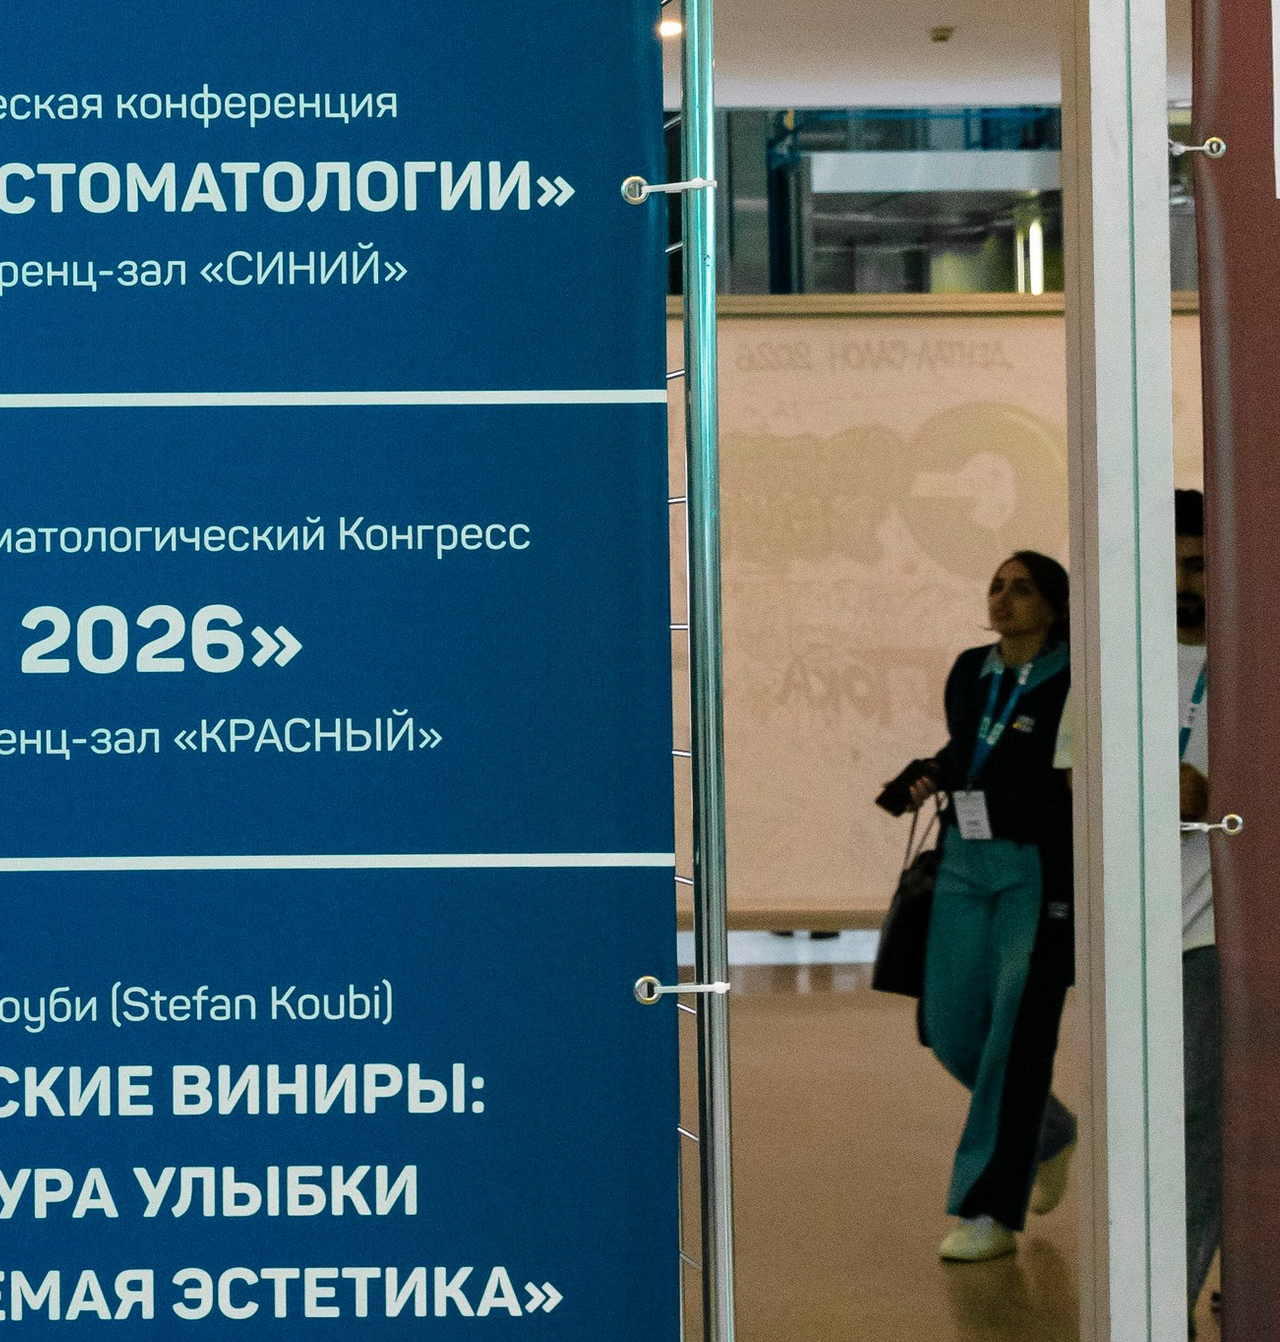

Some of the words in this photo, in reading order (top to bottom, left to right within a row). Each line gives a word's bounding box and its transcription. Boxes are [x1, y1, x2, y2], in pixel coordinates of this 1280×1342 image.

[118, 84, 398, 129] конференция
[201, 243, 408, 287] «СИНИЙ»
[340, 517, 531, 561] Конгресс
[22, 605, 304, 675] 2026»
[175, 709, 443, 754] «КРАСНЫЙ»
[112, 982, 257, 1029] (Stefan
[272, 980, 393, 1026] Koubi)
[173, 1063, 486, 1117] ВИНИРЫ:
[133, 1166, 419, 1219] УЛЫБКИ
[173, 1267, 564, 1321] ЭСТЕТИКА»
